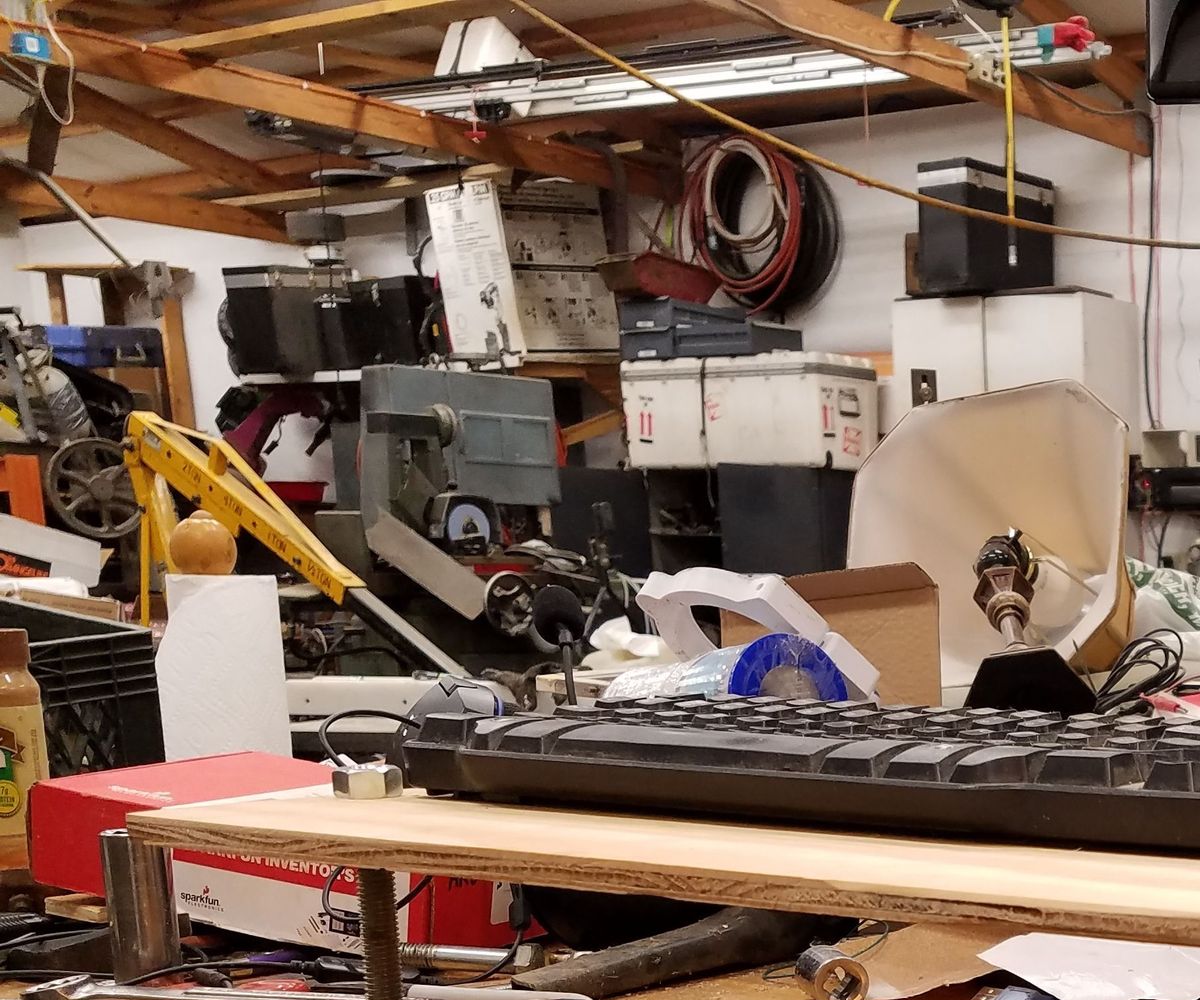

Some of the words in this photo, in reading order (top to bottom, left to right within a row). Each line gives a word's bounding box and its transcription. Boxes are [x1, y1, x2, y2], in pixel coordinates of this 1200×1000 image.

[264, 855, 355, 883] INVENTO'S
[180, 892, 220, 907] sparkfun
[187, 901, 224, 913] ELECTRONICS
